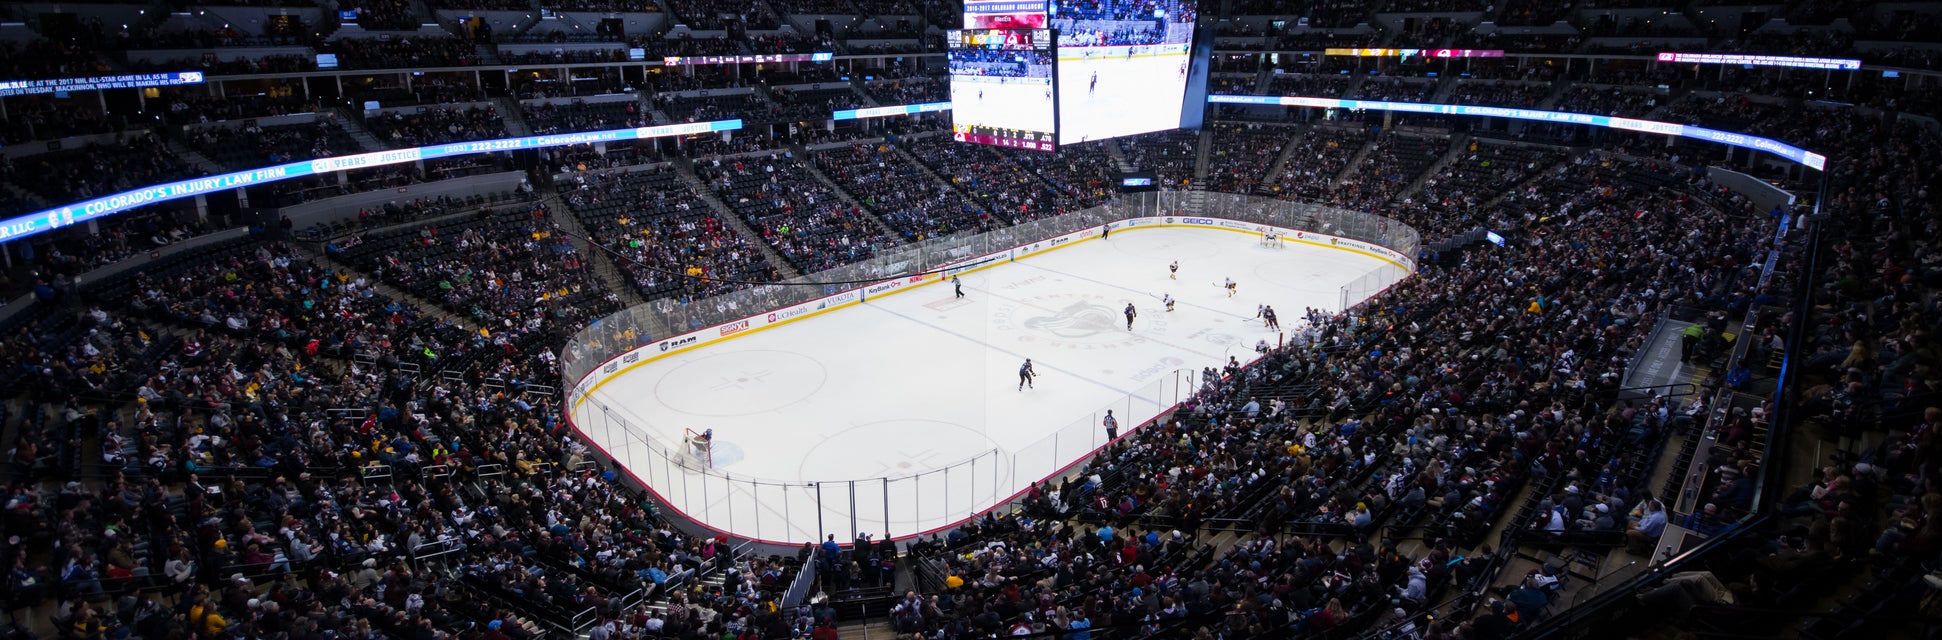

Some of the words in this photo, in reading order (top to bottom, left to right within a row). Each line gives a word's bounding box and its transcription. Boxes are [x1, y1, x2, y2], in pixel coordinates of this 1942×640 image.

[59, 78, 73, 86] 2017
[89, 75, 116, 84] ALL-STAR
[135, 79, 159, 87] MAKING
[471, 139, 521, 151] 222-2222
[537, 133, 617, 145] ColoradoLaw.net
[334, 156, 367, 168] YEARS
[380, 150, 417, 162] JUSTICE
[85, 187, 167, 215] COLORADO'S
[171, 178, 225, 195] INJURY
[225, 173, 252, 186] LAW
[258, 167, 286, 180] FIRM
[14, 220, 36, 235] LLC
[868, 284, 890, 294] KeyBank
[826, 291, 855, 305] VUKOTA
[777, 306, 808, 320] UCHealth
[671, 336, 697, 347] RAM
